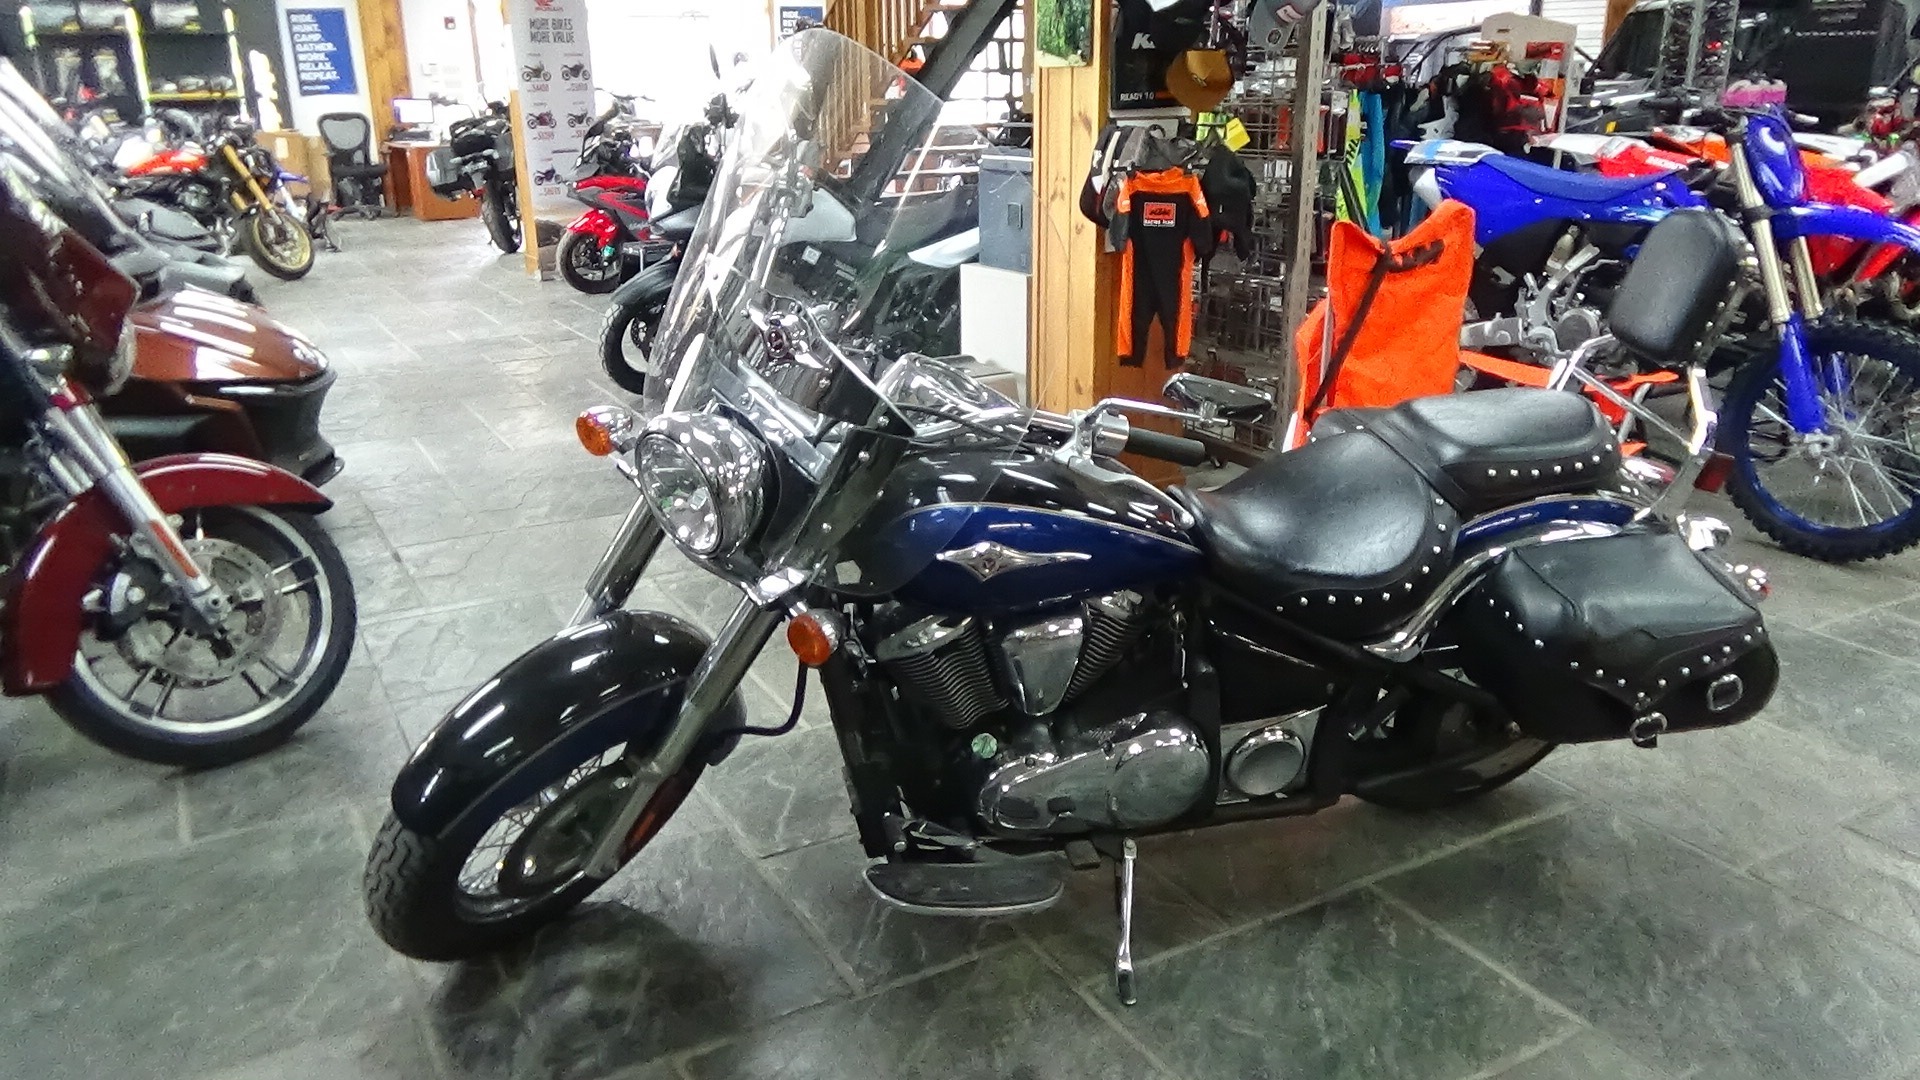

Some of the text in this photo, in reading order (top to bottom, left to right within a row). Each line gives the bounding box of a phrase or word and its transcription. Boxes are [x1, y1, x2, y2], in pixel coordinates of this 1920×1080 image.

[529, 18, 573, 31] MORE BIKES
[530, 31, 576, 43] MORE VALUE
[1120, 92, 1143, 101] READY
